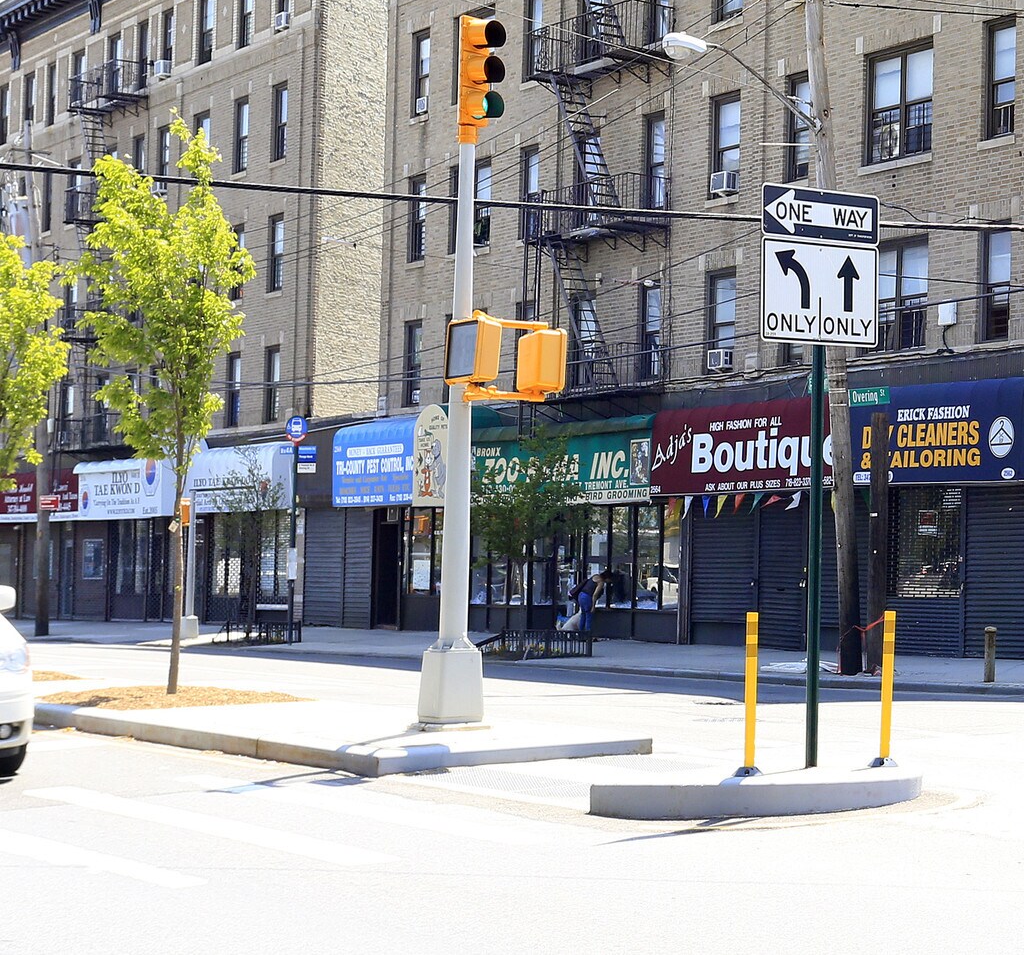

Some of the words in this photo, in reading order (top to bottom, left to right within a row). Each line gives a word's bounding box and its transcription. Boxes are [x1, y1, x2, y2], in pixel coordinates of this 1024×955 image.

[776, 202, 812, 223] ONE
[833, 208, 868, 228] WAY
[767, 312, 816, 333] ONLY
[824, 316, 872, 336] ONLY
[852, 390, 878, 404] Overing
[897, 408, 926, 422] ERICK
[928, 405, 970, 420] FASHION
[710, 422, 724, 432] HIGH
[726, 420, 752, 430] FASHION
[754, 418, 768, 428] FOR
[770, 416, 782, 426] ALL
[897, 420, 980, 448] CLEANERS
[476, 447, 501, 457] BRONX
[651, 424, 692, 471] Adja's
[590, 450, 629, 480] INC.
[888, 448, 980, 468] AILORING
[336, 460, 366, 475] TRI-COUNTY
[366, 458, 380, 474] PEST
[112, 472, 128, 483] ILYO
[194, 478, 206, 486] ILYO
[585, 481, 612, 490] TREMONT
[615, 480, 629, 488] AVE.
[95, 484, 108, 496] TAE
[110, 484, 132, 495] KWON
[650, 486, 661, 494] 2564
[705, 482, 716, 492] ASK
[718, 482, 734, 491] ABOUT
[737, 480, 748, 490] OUR
[750, 480, 764, 490] PLUS
[766, 479, 780, 488] SIZES
[586, 490, 602, 500] BIRD
[606, 488, 648, 500] GROOMING
